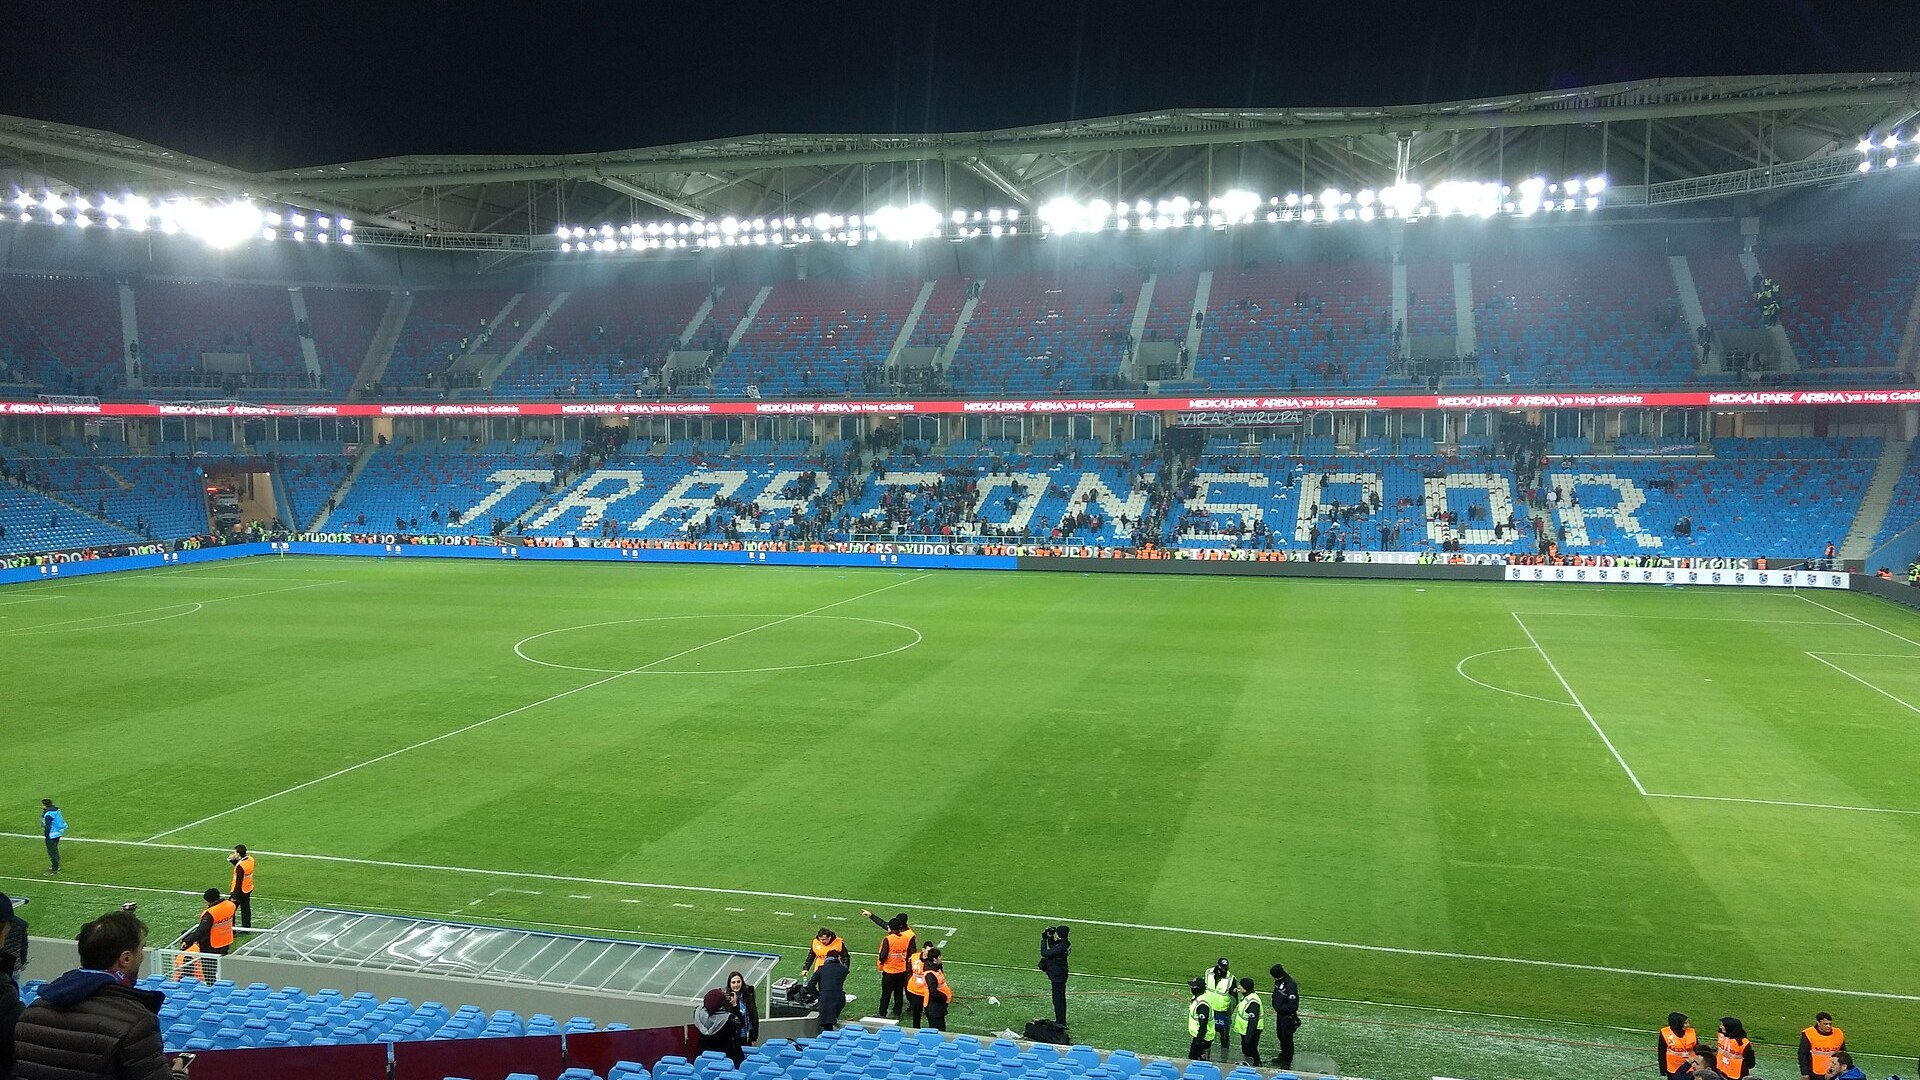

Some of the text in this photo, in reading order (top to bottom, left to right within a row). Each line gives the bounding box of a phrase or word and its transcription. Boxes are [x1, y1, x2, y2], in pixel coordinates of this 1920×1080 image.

[1189, 399, 1258, 409] MEDICALPARK
[1314, 398, 1335, 408] Hoş
[1336, 397, 1378, 407] Geldiniz
[1437, 395, 1514, 407] MEDICALPARK
[1575, 395, 1597, 405] Hoş
[1598, 394, 1644, 404] Geldiniz
[1709, 392, 1795, 404] MEDICALPARK
[1864, 391, 1889, 403] Hoş
[488, 405, 520, 413] Geldiniz
[562, 405, 618, 414] MEDICALPARK
[661, 405, 677, 413] Hoş
[678, 404, 711, 412] Geldiniz
[756, 403, 815, 413] MEDICALPARK
[861, 403, 879, 412] Hoş
[879, 403, 915, 411] Geldiniz
[963, 402, 1027, 412] MEDICALPARK
[1077, 401, 1096, 411] Hoş
[1096, 401, 1136, 410] Geldiniz
[1238, 410, 1300, 425] AVRUPA
